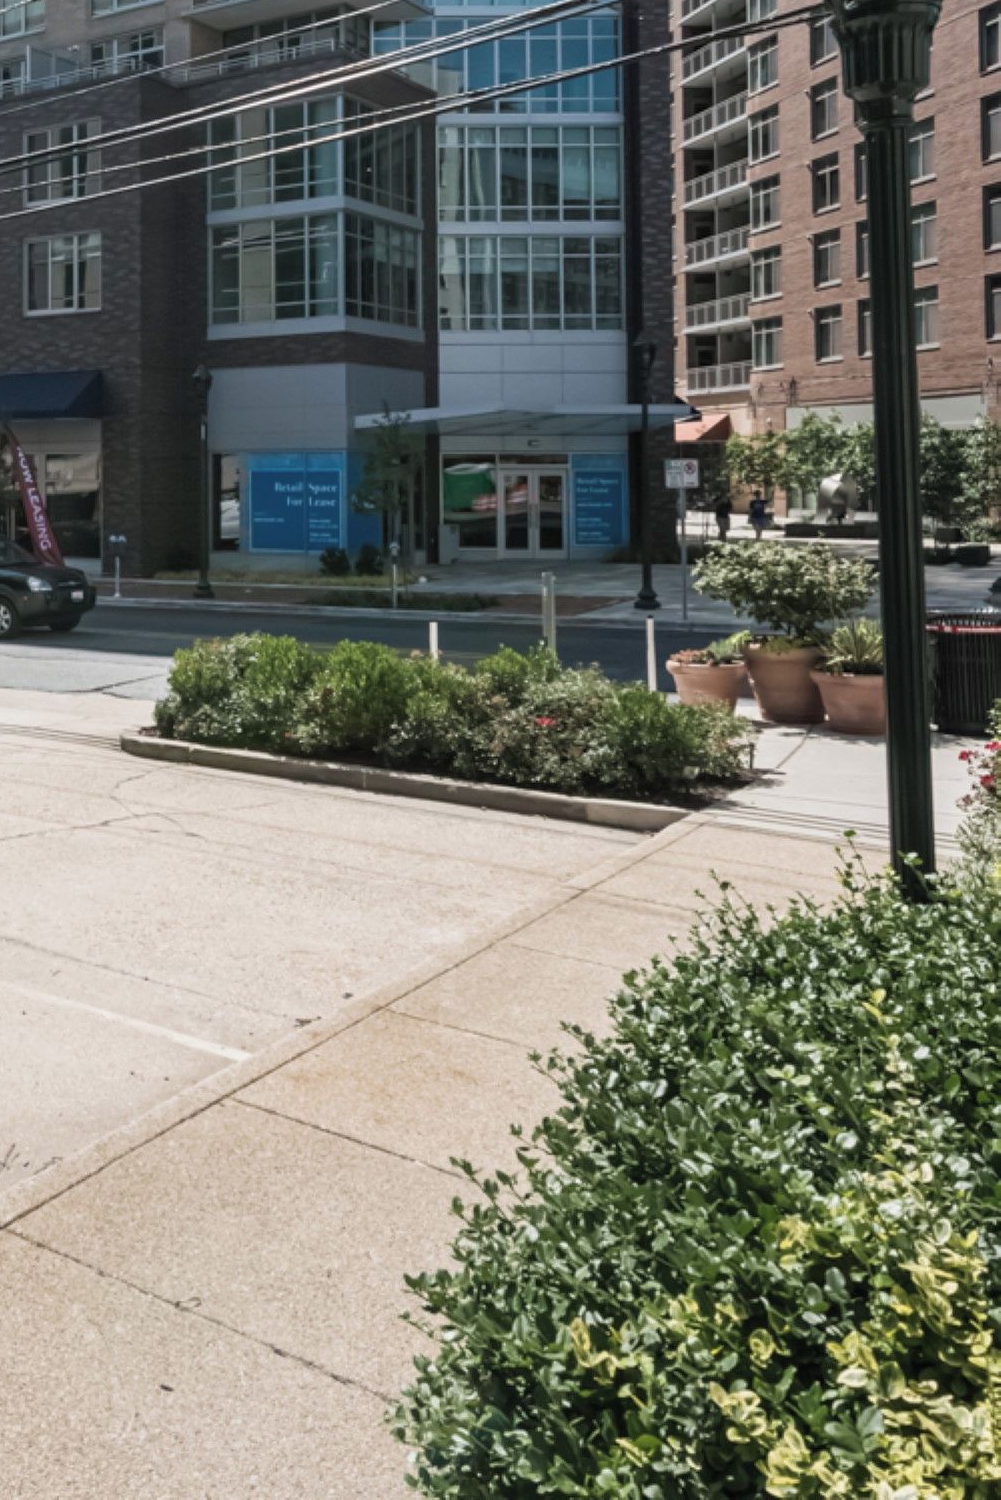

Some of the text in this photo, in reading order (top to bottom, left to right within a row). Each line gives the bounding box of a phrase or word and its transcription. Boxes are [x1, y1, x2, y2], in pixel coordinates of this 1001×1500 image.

[275, 482, 337, 495] Retail Space
[286, 496, 336, 506] For Lease
[28, 488, 51, 550] LEASING
